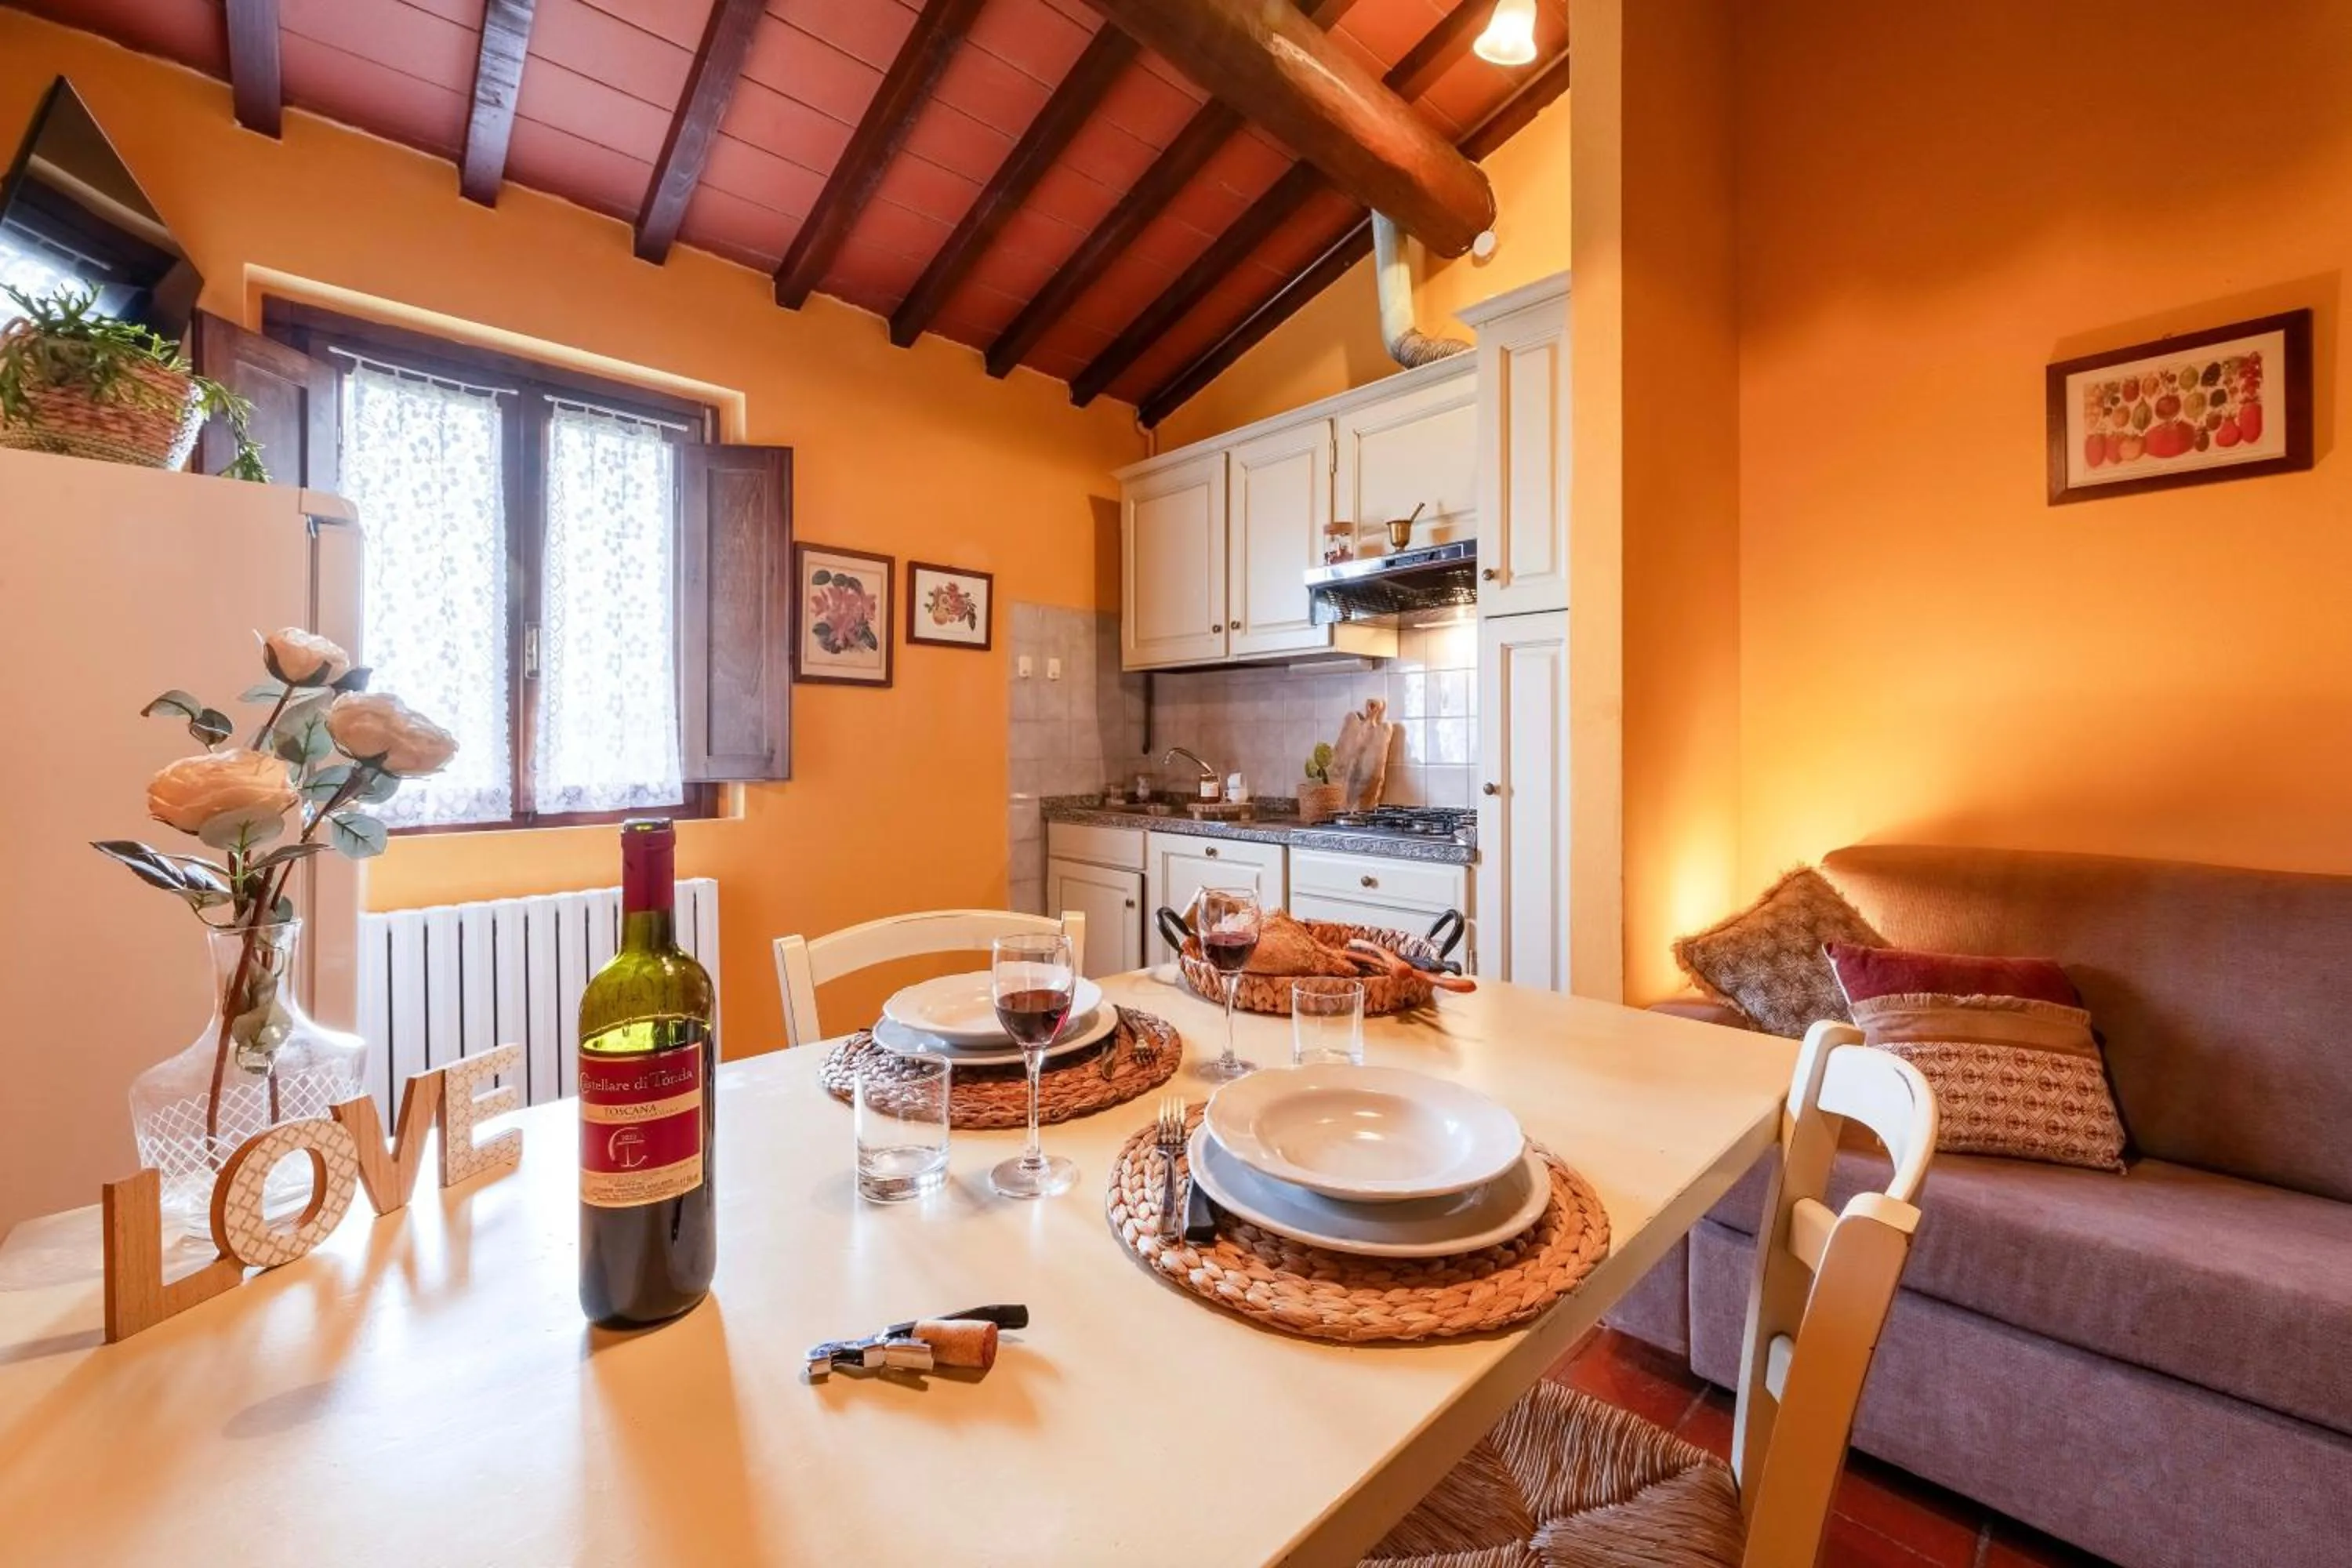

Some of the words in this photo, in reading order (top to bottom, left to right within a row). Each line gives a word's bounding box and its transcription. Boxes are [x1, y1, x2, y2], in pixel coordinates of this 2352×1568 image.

[634, 1076, 648, 1091] di
[604, 1104, 656, 1116] TOSCANA
[103, 1044, 523, 1344] LOVE
